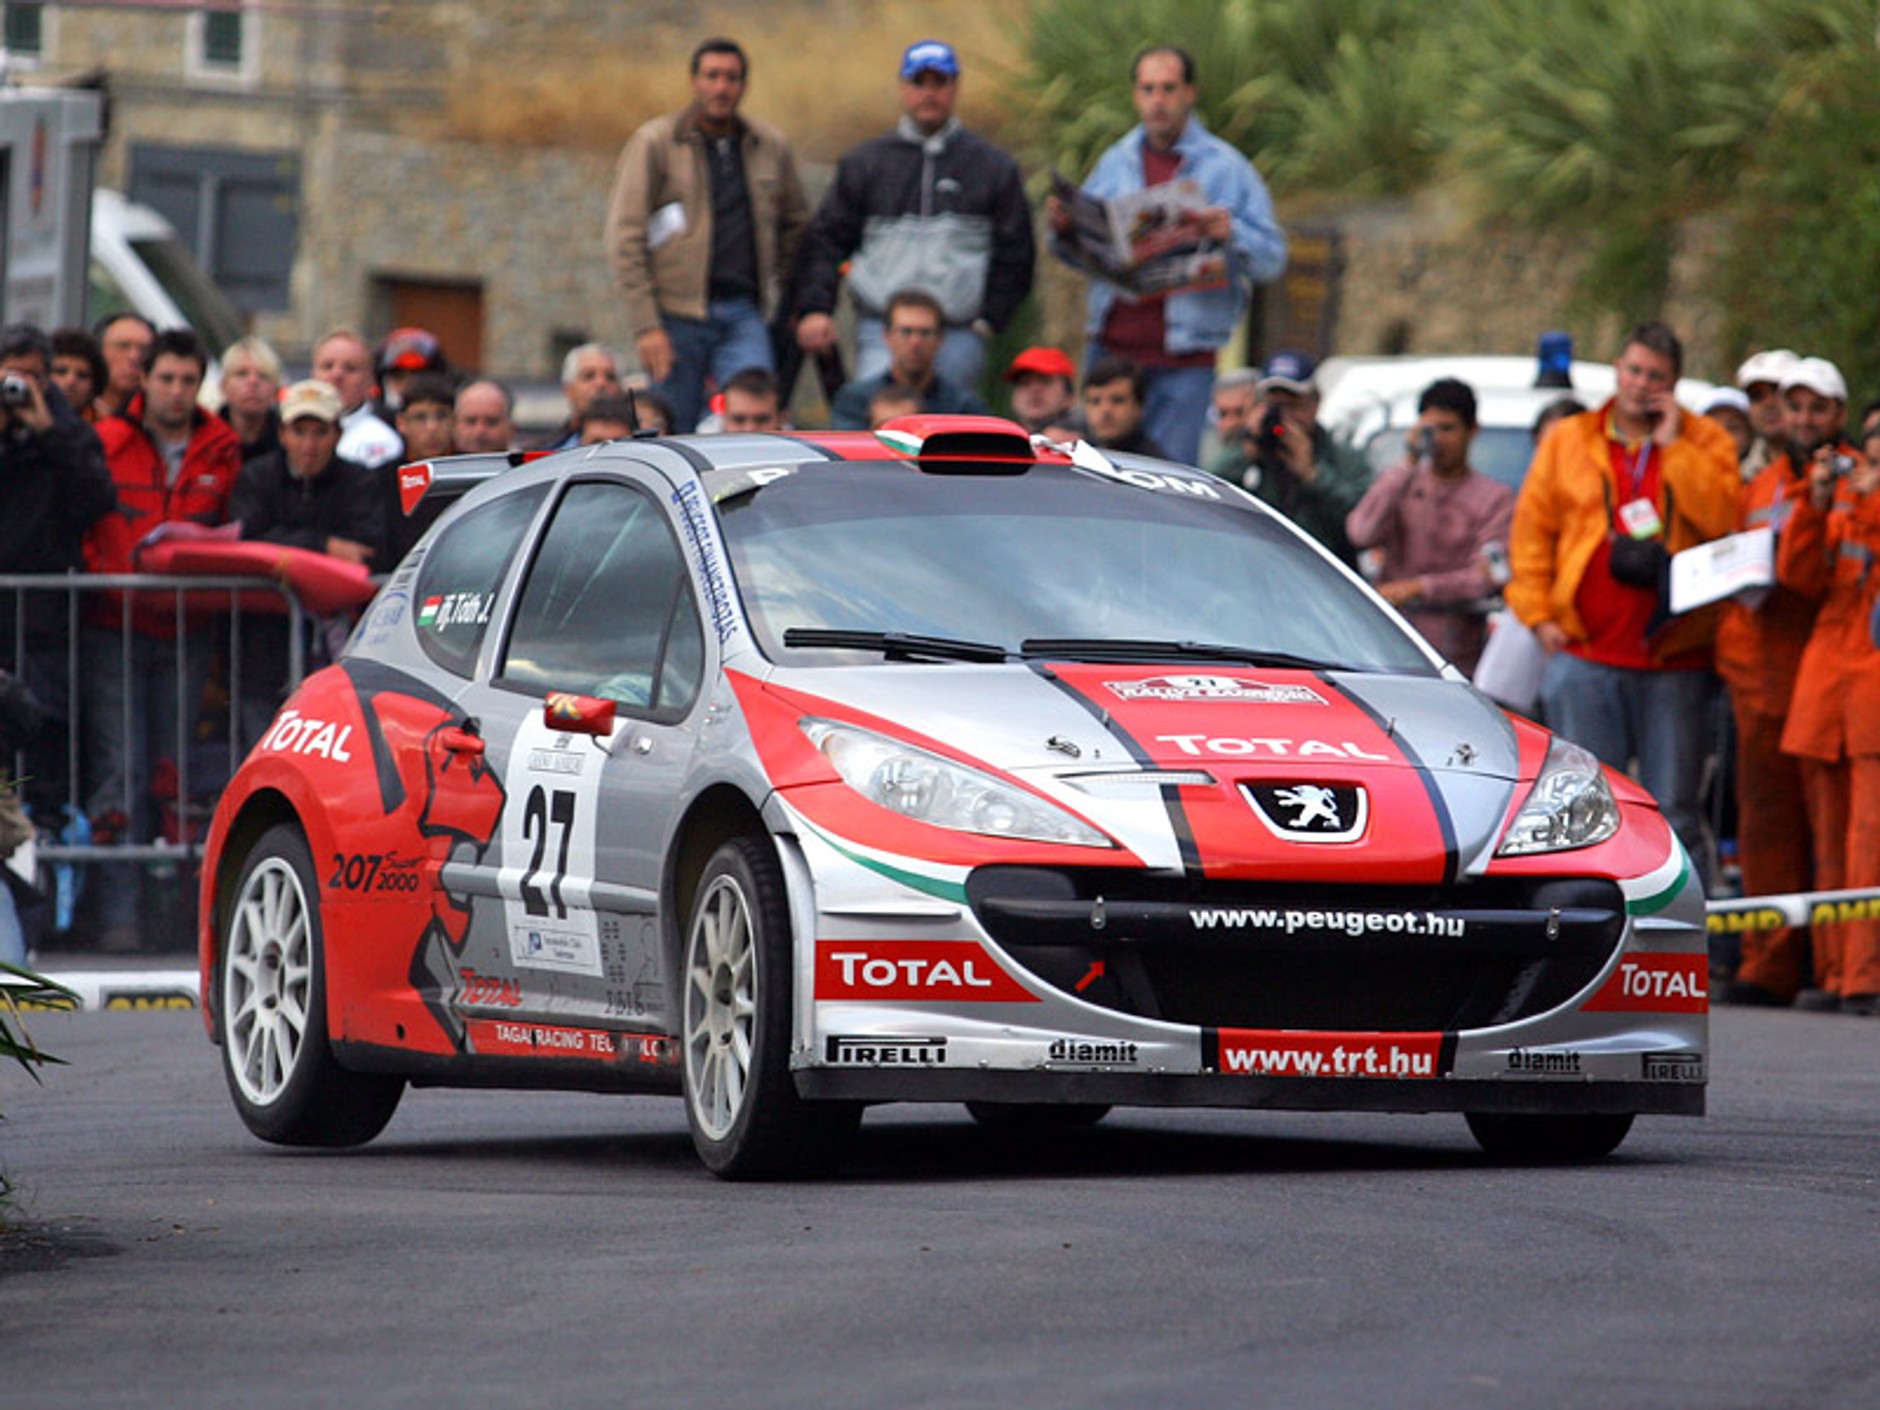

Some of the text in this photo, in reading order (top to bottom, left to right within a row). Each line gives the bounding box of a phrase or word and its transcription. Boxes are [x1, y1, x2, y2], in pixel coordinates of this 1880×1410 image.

[263, 710, 352, 762] TOTAL
[1156, 735, 1389, 760] TOTAL
[520, 784, 576, 920] 27
[328, 853, 383, 892] 207
[377, 872, 418, 892] 2000
[1190, 908, 1465, 937] www.peugeot.hu
[831, 953, 992, 986] TOTAL
[1621, 964, 1707, 997] TOTAL
[459, 968, 522, 1007] TOTAL
[536, 1029, 584, 1050] RACING
[826, 1035, 947, 1064] PIRELLI
[1049, 1038, 1138, 1062] diamit
[1225, 1046, 1432, 1074] www.trt.hu
[1508, 1047, 1581, 1071] diamit
[1641, 1052, 1703, 1080] PIRELLI
